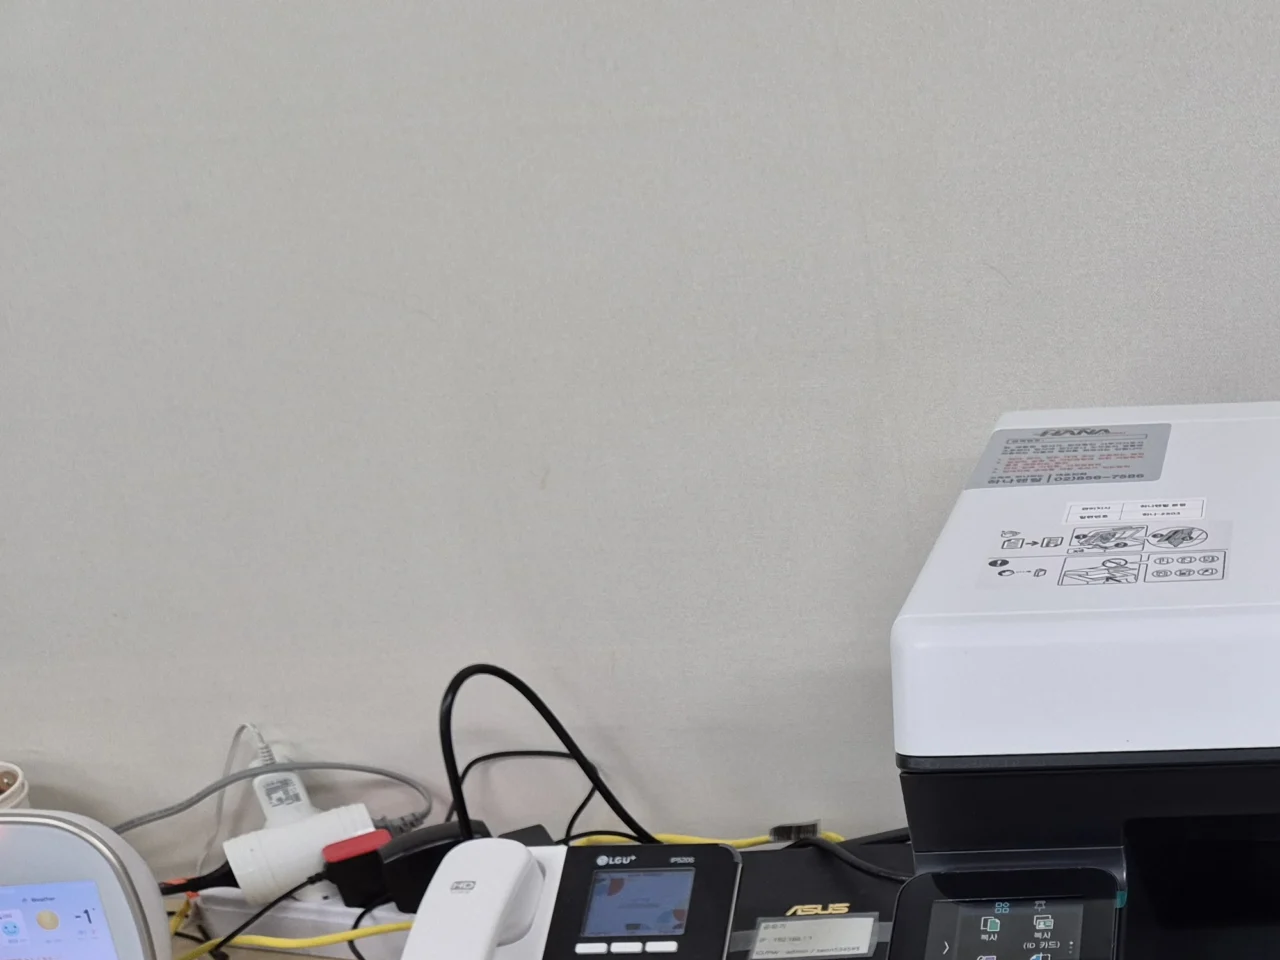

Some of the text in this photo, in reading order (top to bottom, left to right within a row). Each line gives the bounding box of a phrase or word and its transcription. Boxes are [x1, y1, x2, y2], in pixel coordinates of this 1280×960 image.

[785, 902, 851, 916] ASUS
[1023, 941, 1060, 950] (ID 카드)
